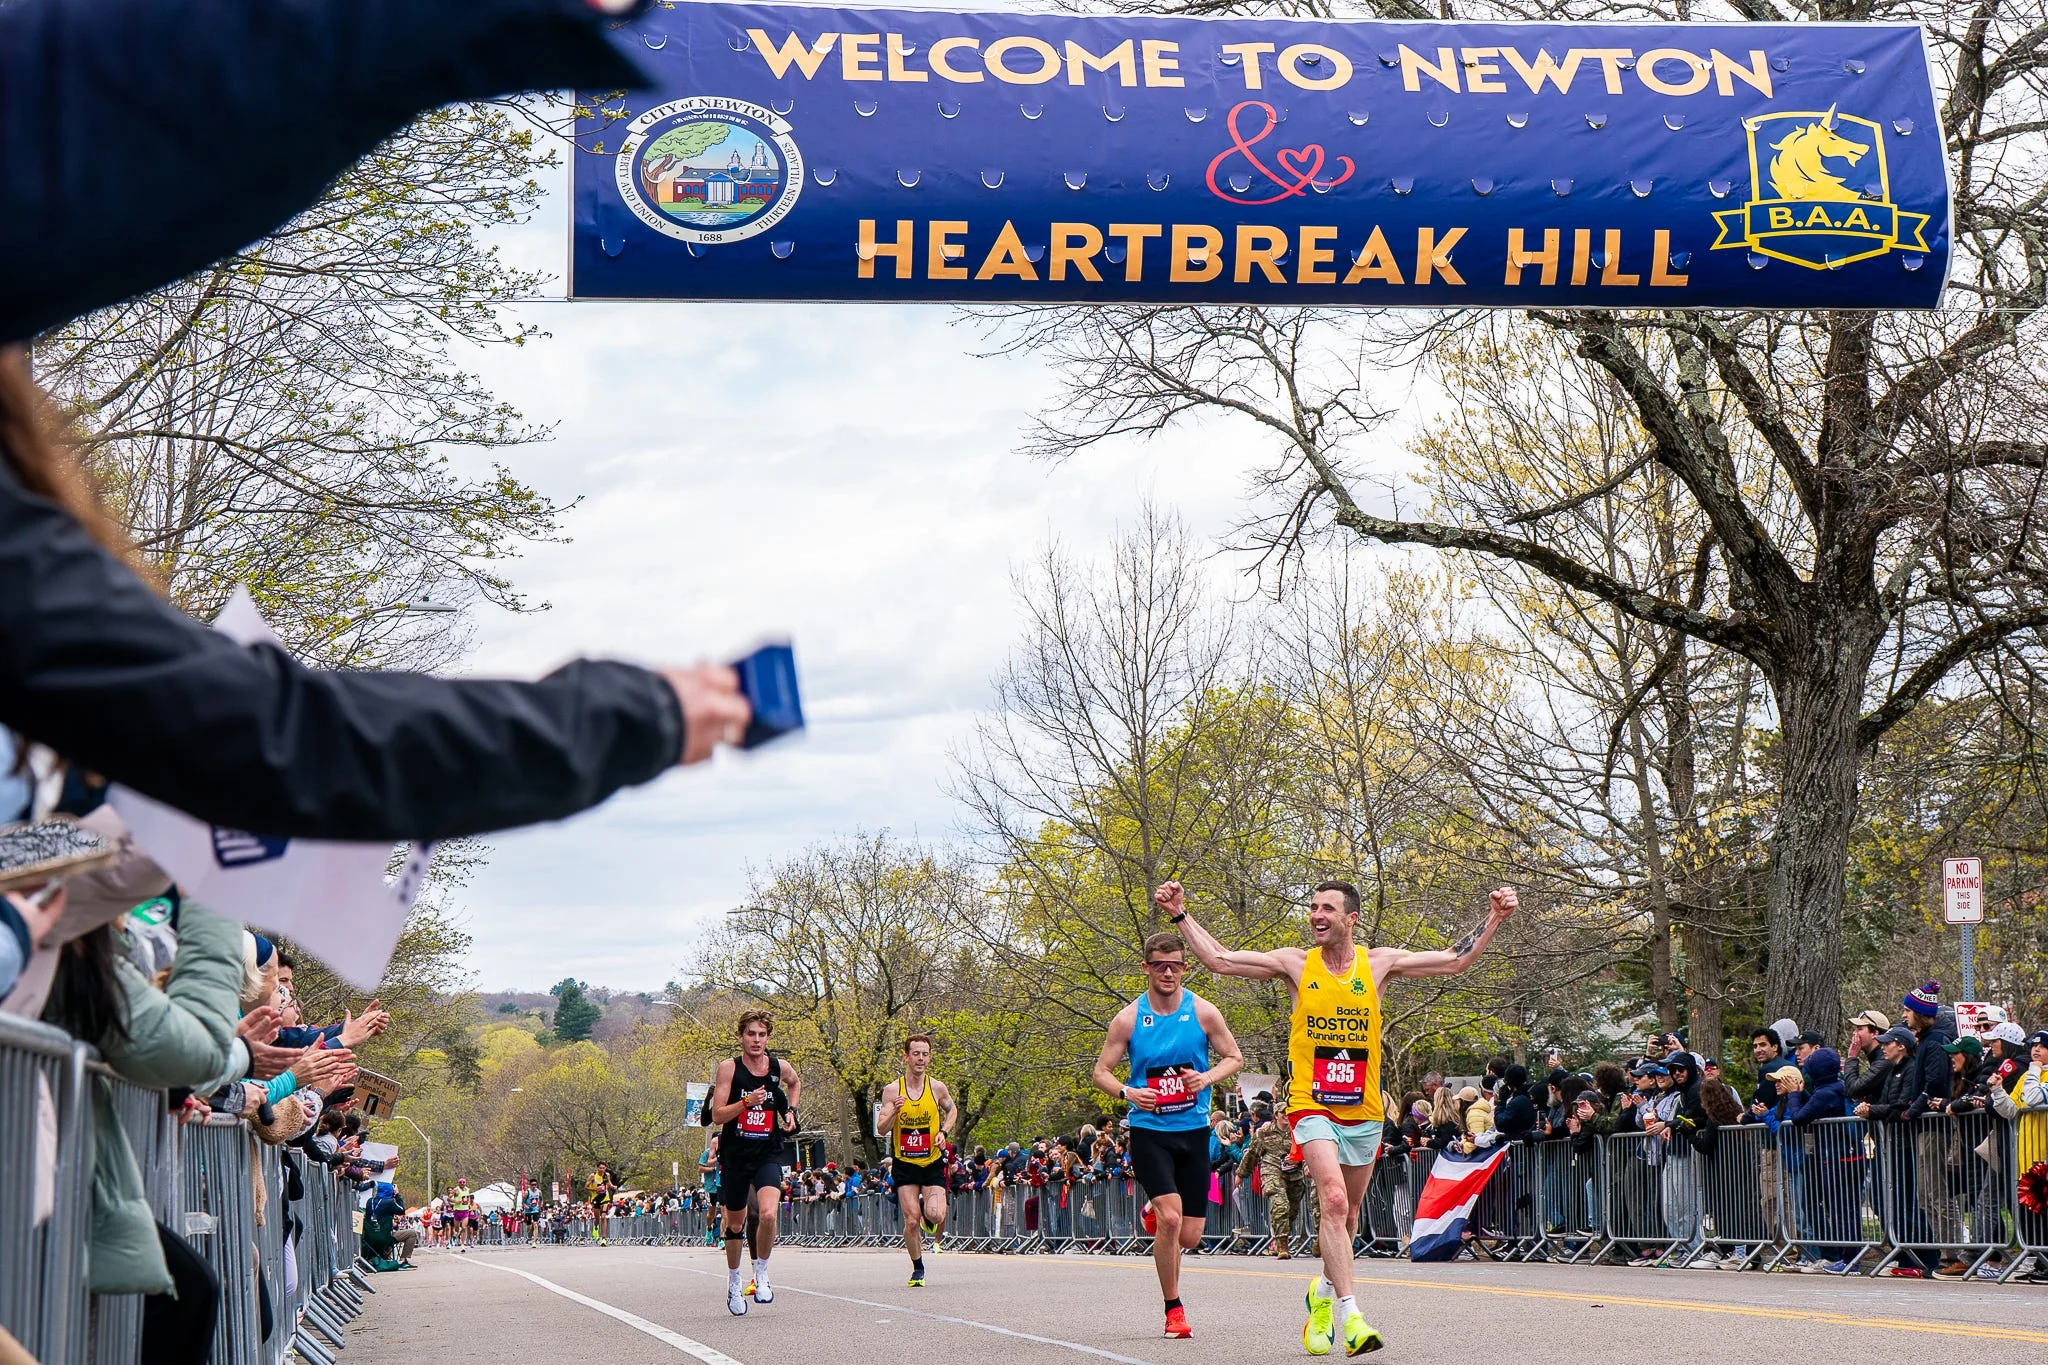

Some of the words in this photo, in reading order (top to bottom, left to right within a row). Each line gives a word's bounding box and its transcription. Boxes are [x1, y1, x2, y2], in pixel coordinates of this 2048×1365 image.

[746, 28, 1186, 88] WELCOME
[1222, 42, 1353, 91] TO
[1398, 43, 1774, 99] NEWTON
[640, 102, 678, 125] CITY
[681, 99, 694, 110] of
[699, 98, 778, 126] NEWTON
[620, 141, 637, 179] LBERTY
[621, 181, 636, 202] AND
[755, 188, 796, 229] THIRTEEN
[782, 142, 800, 186] VILLAGES
[633, 202, 667, 230] UNION
[1768, 205, 1881, 231] B.A.A.
[698, 233, 723, 242] 1688
[857, 219, 1469, 286] HEARTBREAK
[1503, 227, 1689, 287] HILL
[1955, 862, 1969, 875] NO
[1946, 876, 1979, 889] PARKING
[1956, 891, 1971, 900] THIS
[1956, 901, 1971, 910] SIDE
[1336, 1006, 1362, 1016] Back
[1363, 1007, 1370, 1017] 2
[1307, 1015, 1369, 1031] BOSTON
[1307, 1029, 1346, 1043] Running
[1347, 1032, 1368, 1042] Club
[358, 1070, 396, 1093] parkrun
[1326, 1061, 1356, 1084] 335
[358, 1080, 387, 1098] Jamaica
[740, 1088, 774, 1101] baga
[1158, 1077, 1185, 1097] 334
[746, 1111, 766, 1126] 392
[907, 1135, 923, 1147] 421
